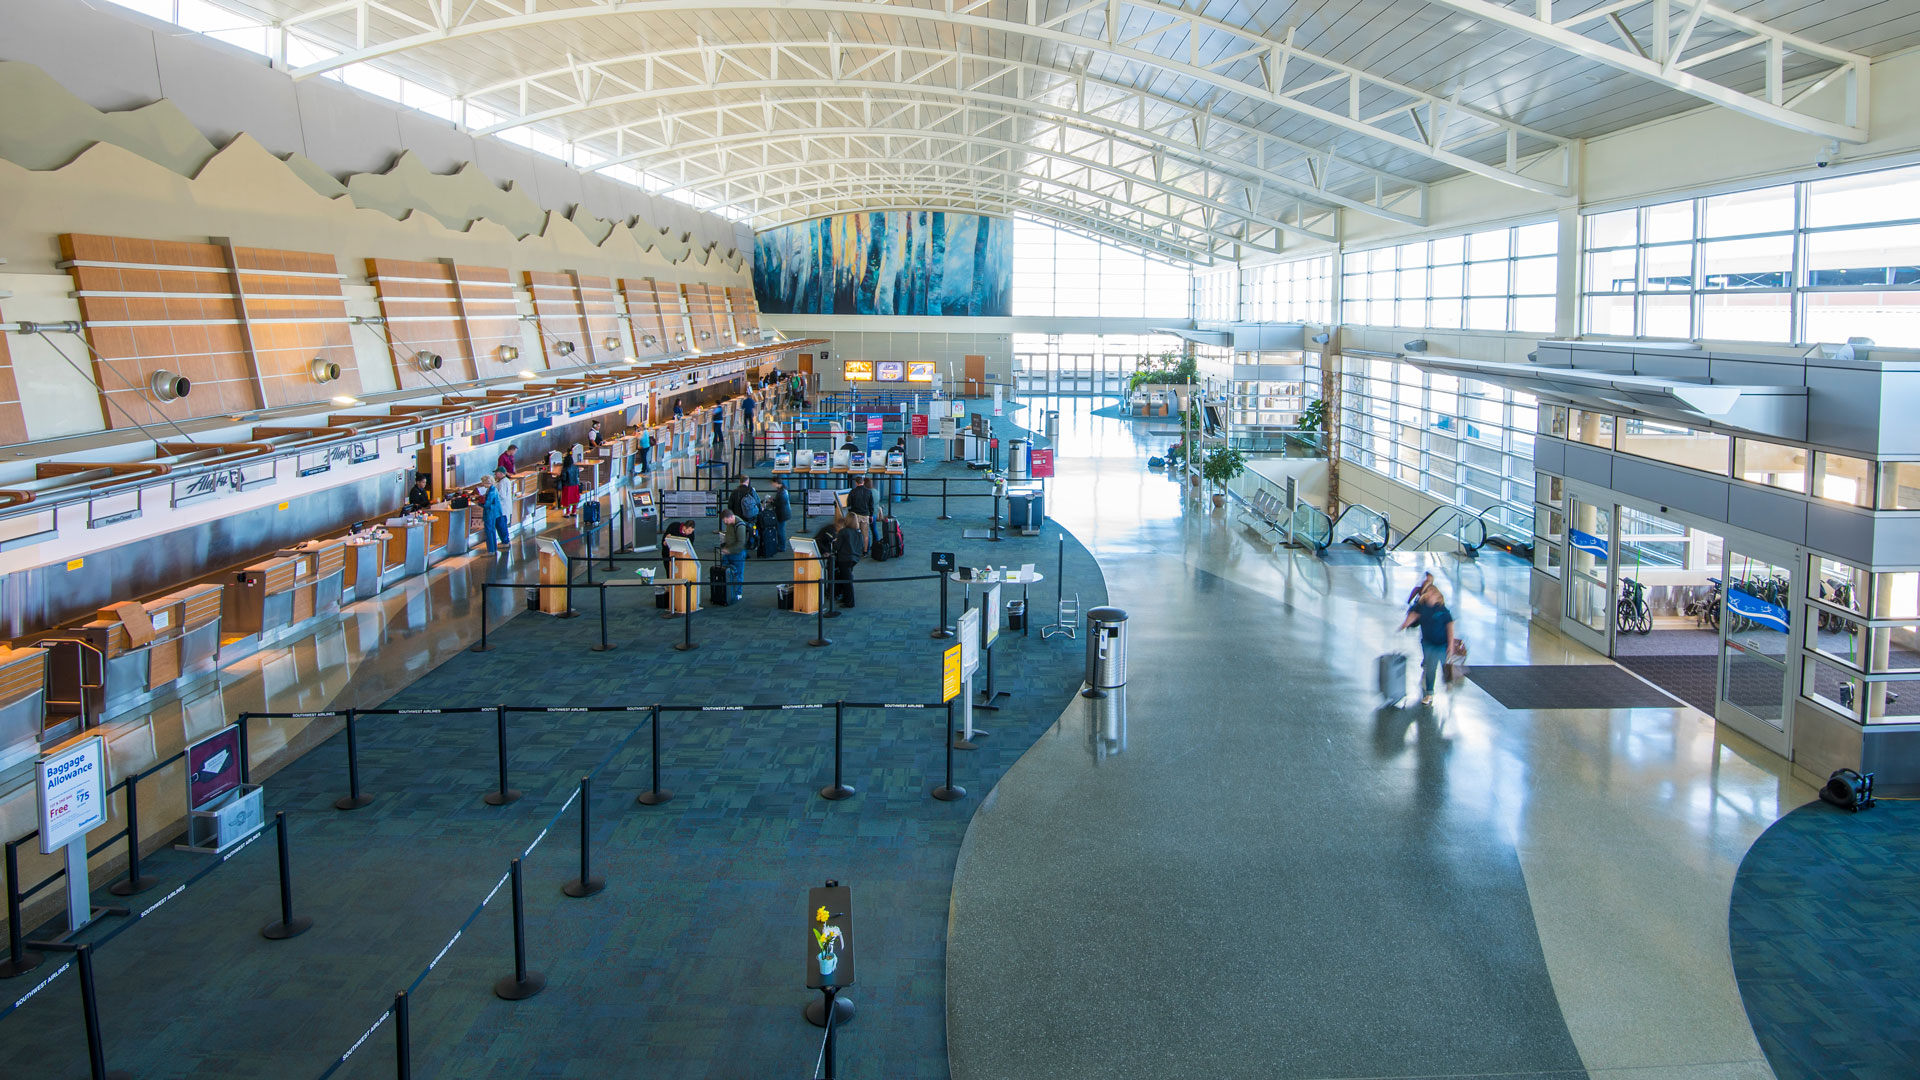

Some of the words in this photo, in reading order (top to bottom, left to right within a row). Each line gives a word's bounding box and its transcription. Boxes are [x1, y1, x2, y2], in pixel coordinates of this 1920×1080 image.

[187, 472, 228, 494] Alaka
[47, 754, 85, 778] Baggage
[48, 762, 92, 789] Allowance
[76, 791, 90, 802] $75
[50, 804, 68, 818] Free
[16, 980, 47, 1008] SOUTHWEST
[47, 962, 70, 984] AIRLINES
[342, 1030, 370, 1061] SOUTHWEST
[370, 1010, 390, 1033] AIRLINES
